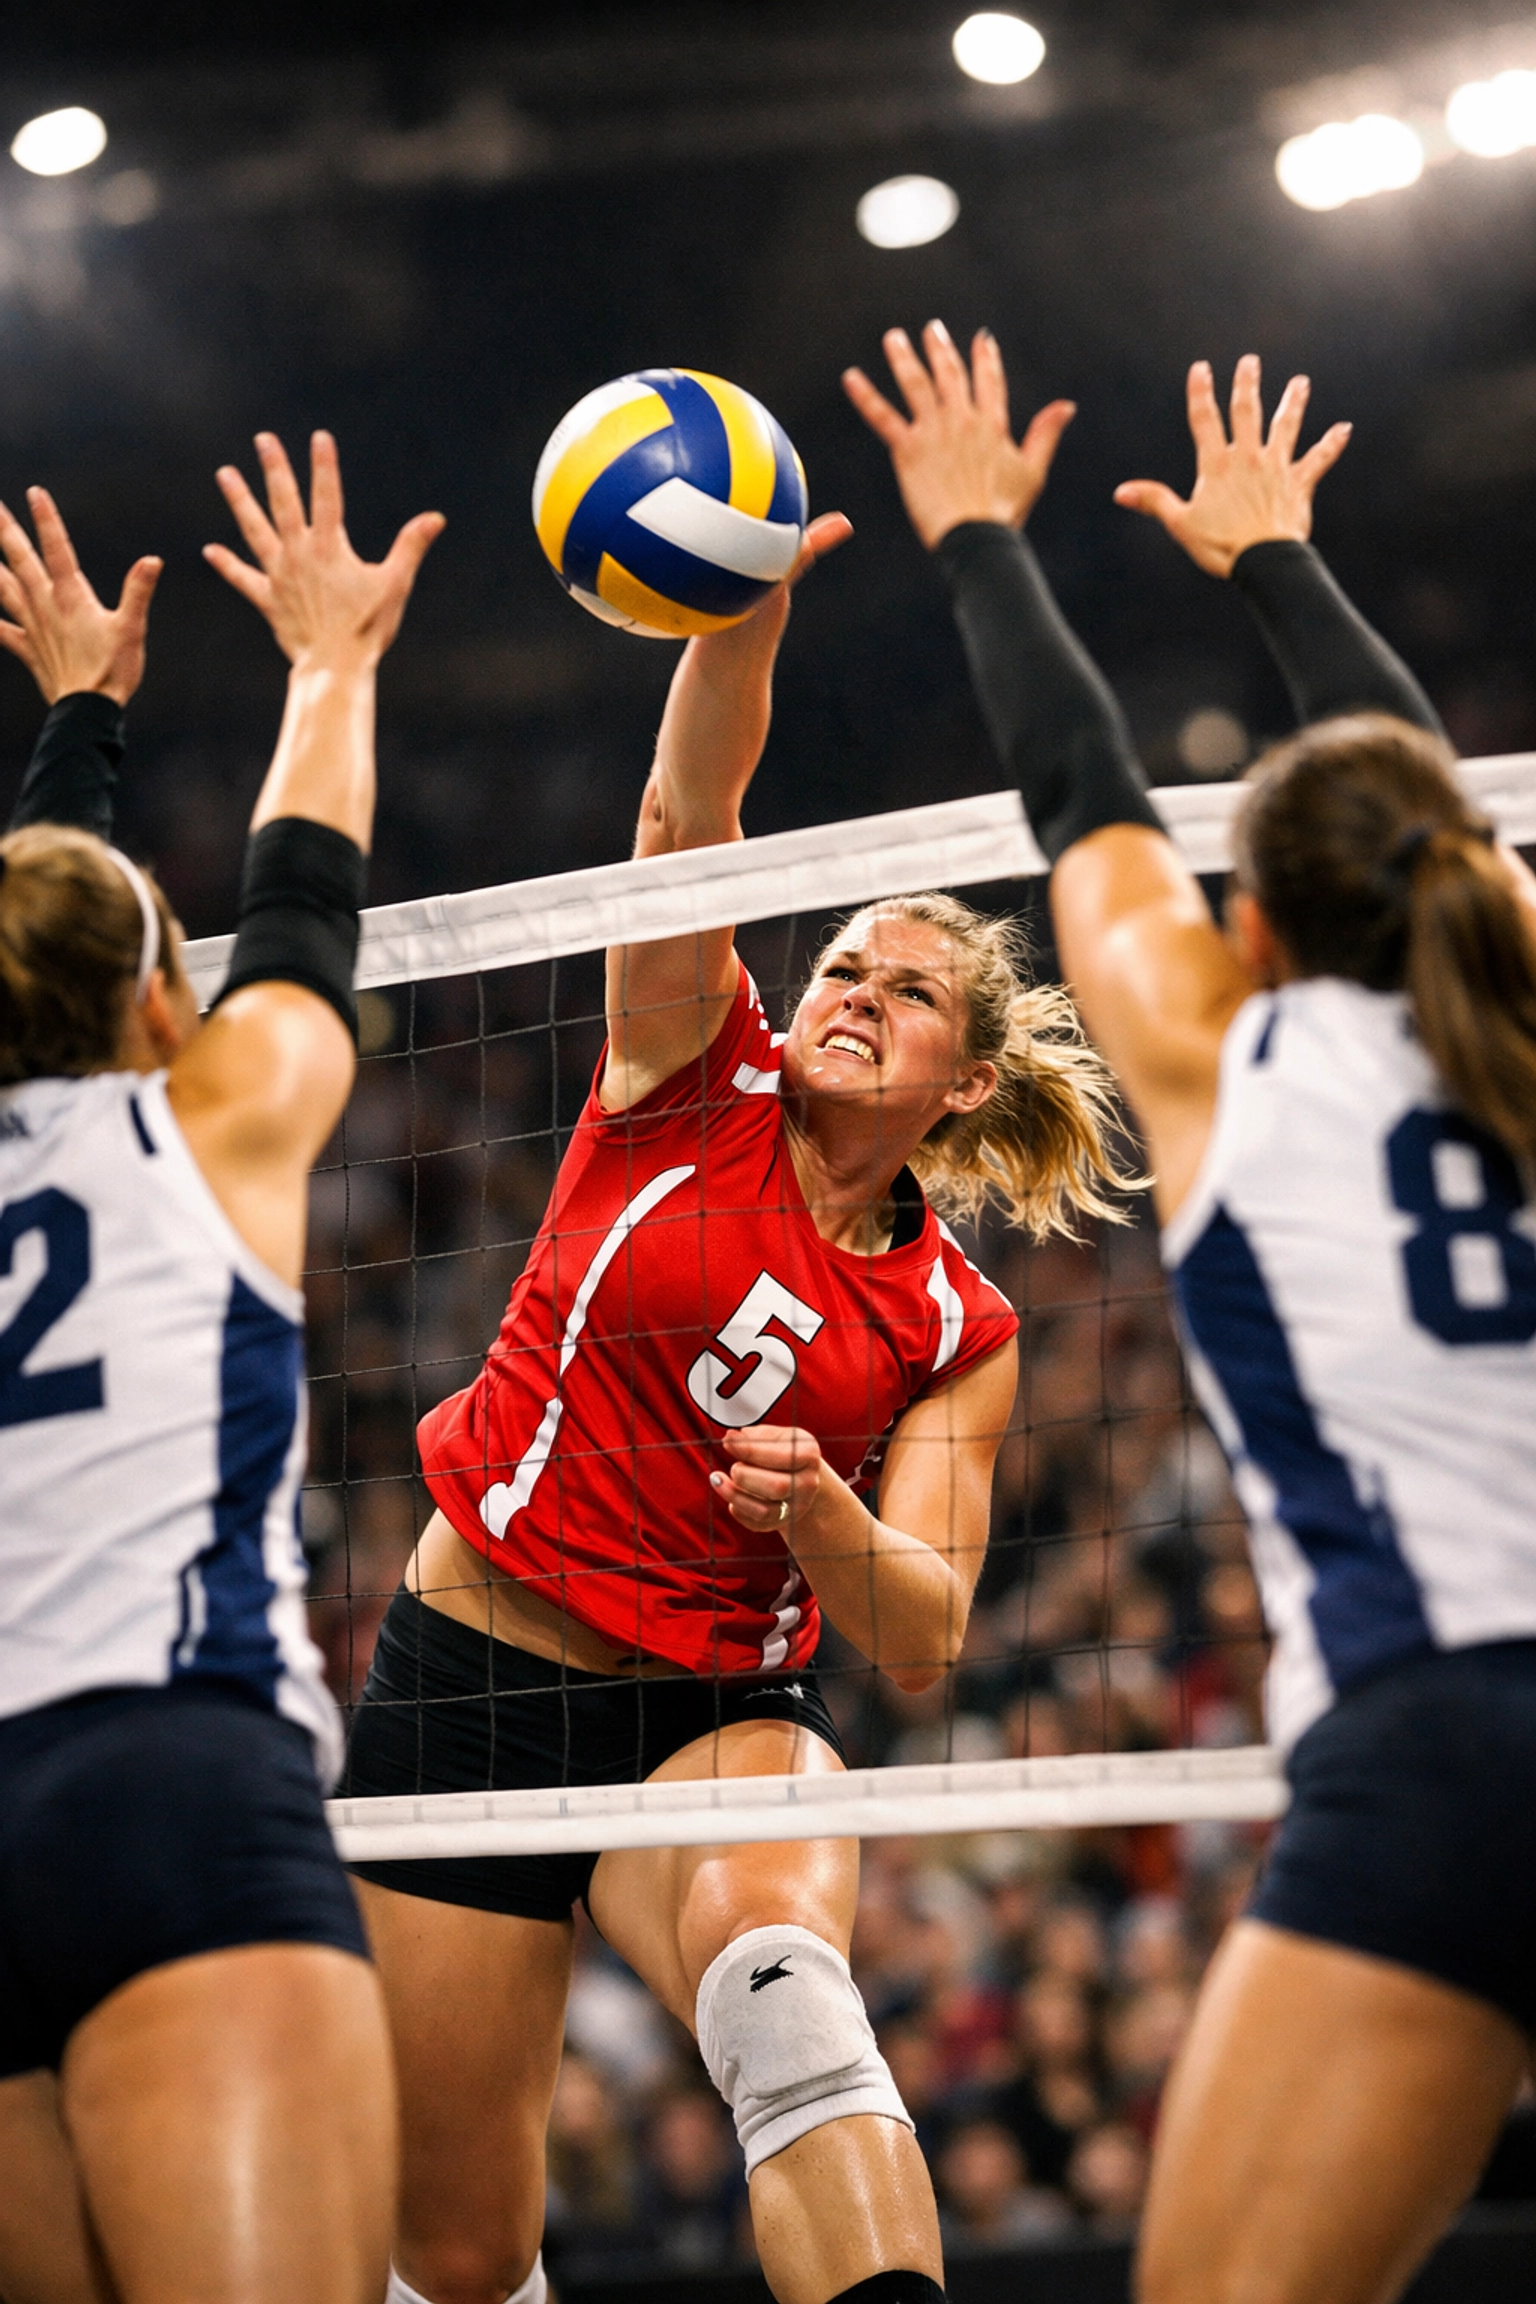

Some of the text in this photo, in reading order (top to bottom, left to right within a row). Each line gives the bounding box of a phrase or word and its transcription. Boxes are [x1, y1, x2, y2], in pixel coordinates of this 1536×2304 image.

[0, 1184, 105, 1428] 2
[1384, 1105, 1536, 1345] 8
[686, 1268, 826, 1428] 5
